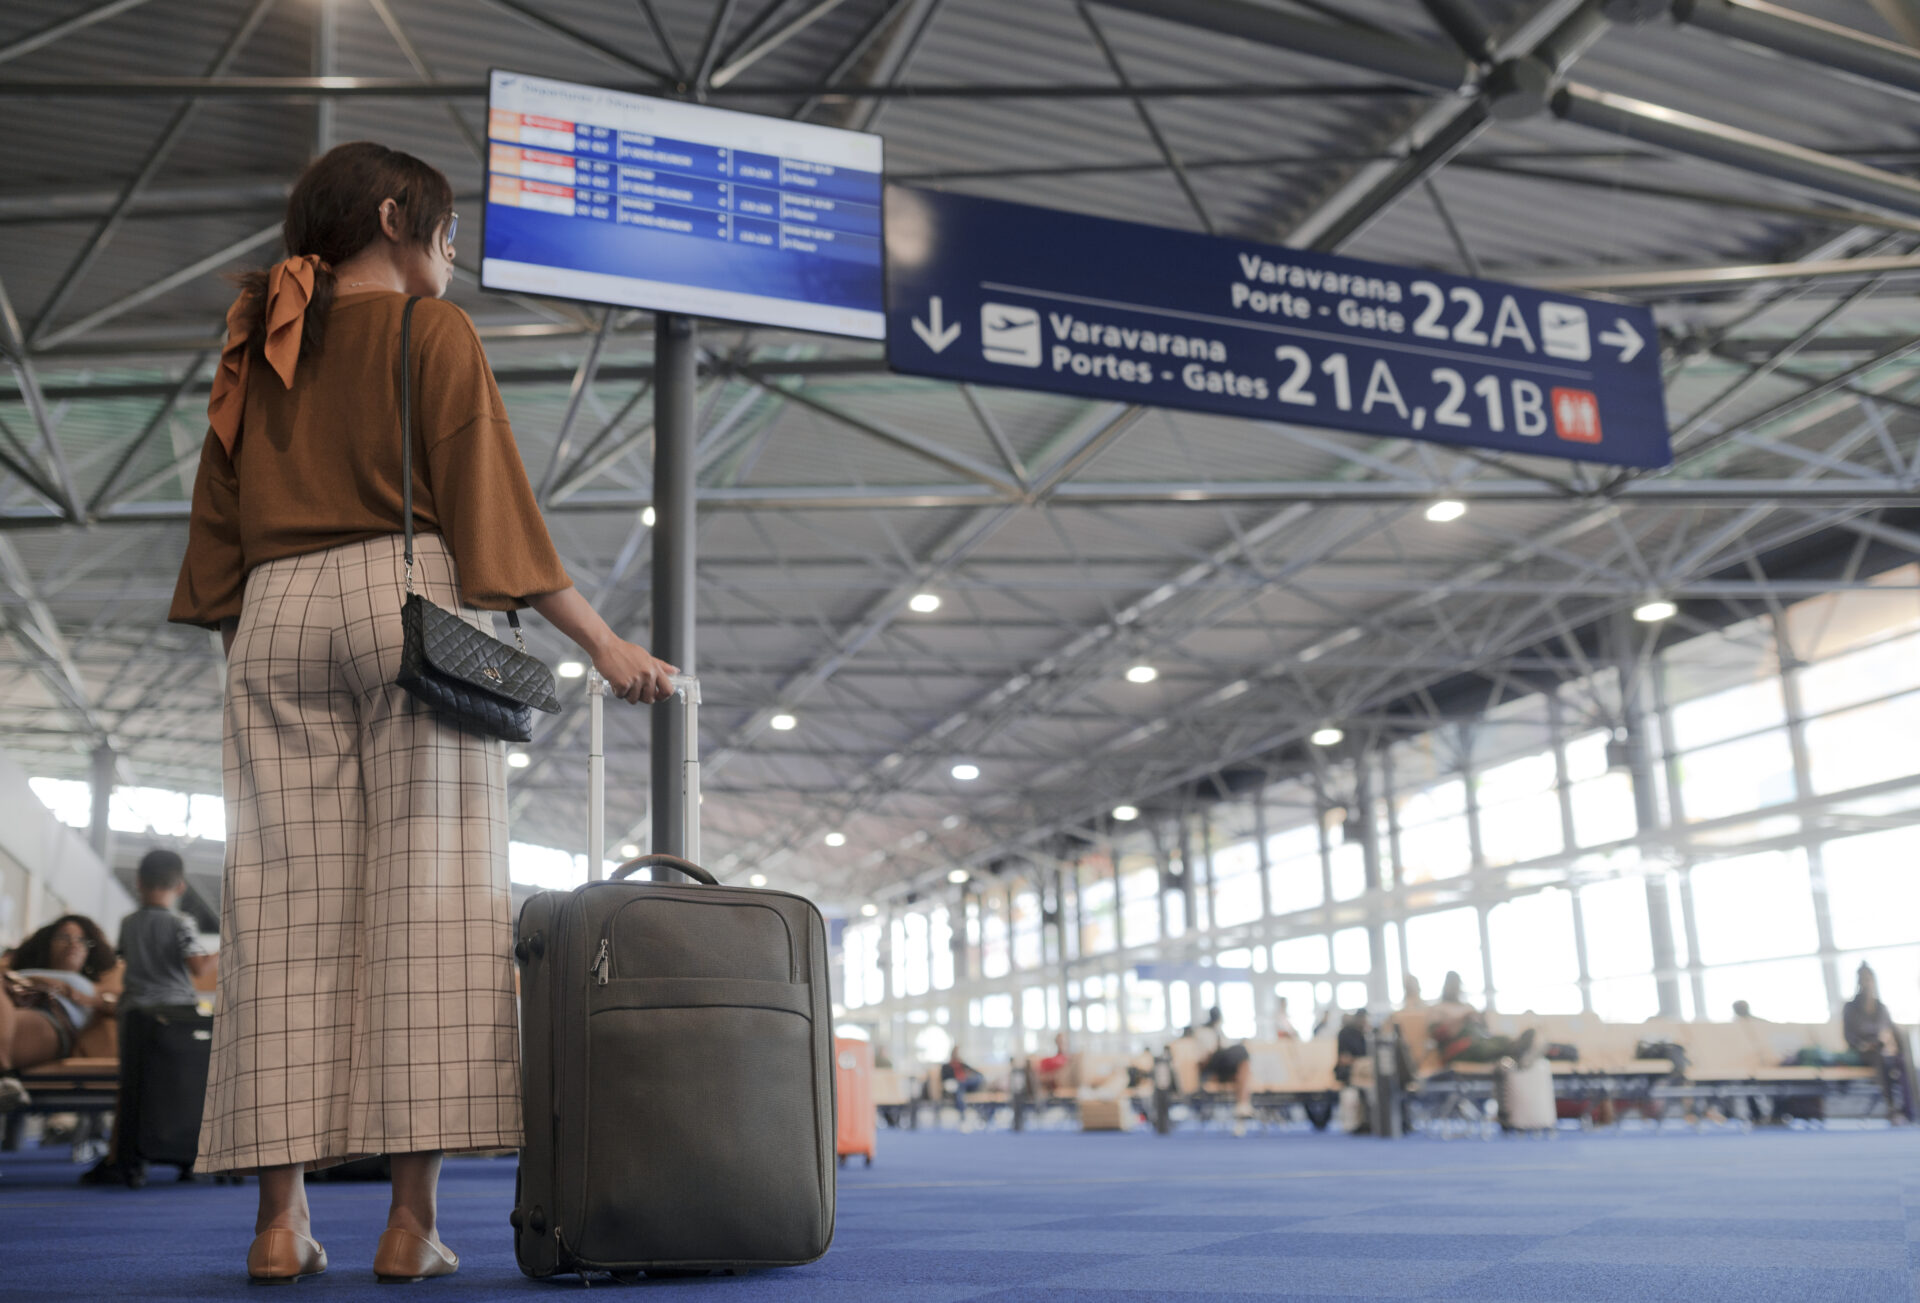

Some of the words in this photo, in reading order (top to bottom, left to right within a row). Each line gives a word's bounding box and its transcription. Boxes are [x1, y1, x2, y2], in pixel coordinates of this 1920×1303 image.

[1238, 253, 1402, 303] Varavarana
[1231, 282, 1310, 319] Porte
[1338, 298, 1405, 333] Gate
[1410, 280, 1536, 354] 22A
[1049, 312, 1227, 363] Varavarana
[1052, 345, 1153, 384] Portes
[1182, 363, 1269, 400] Gates
